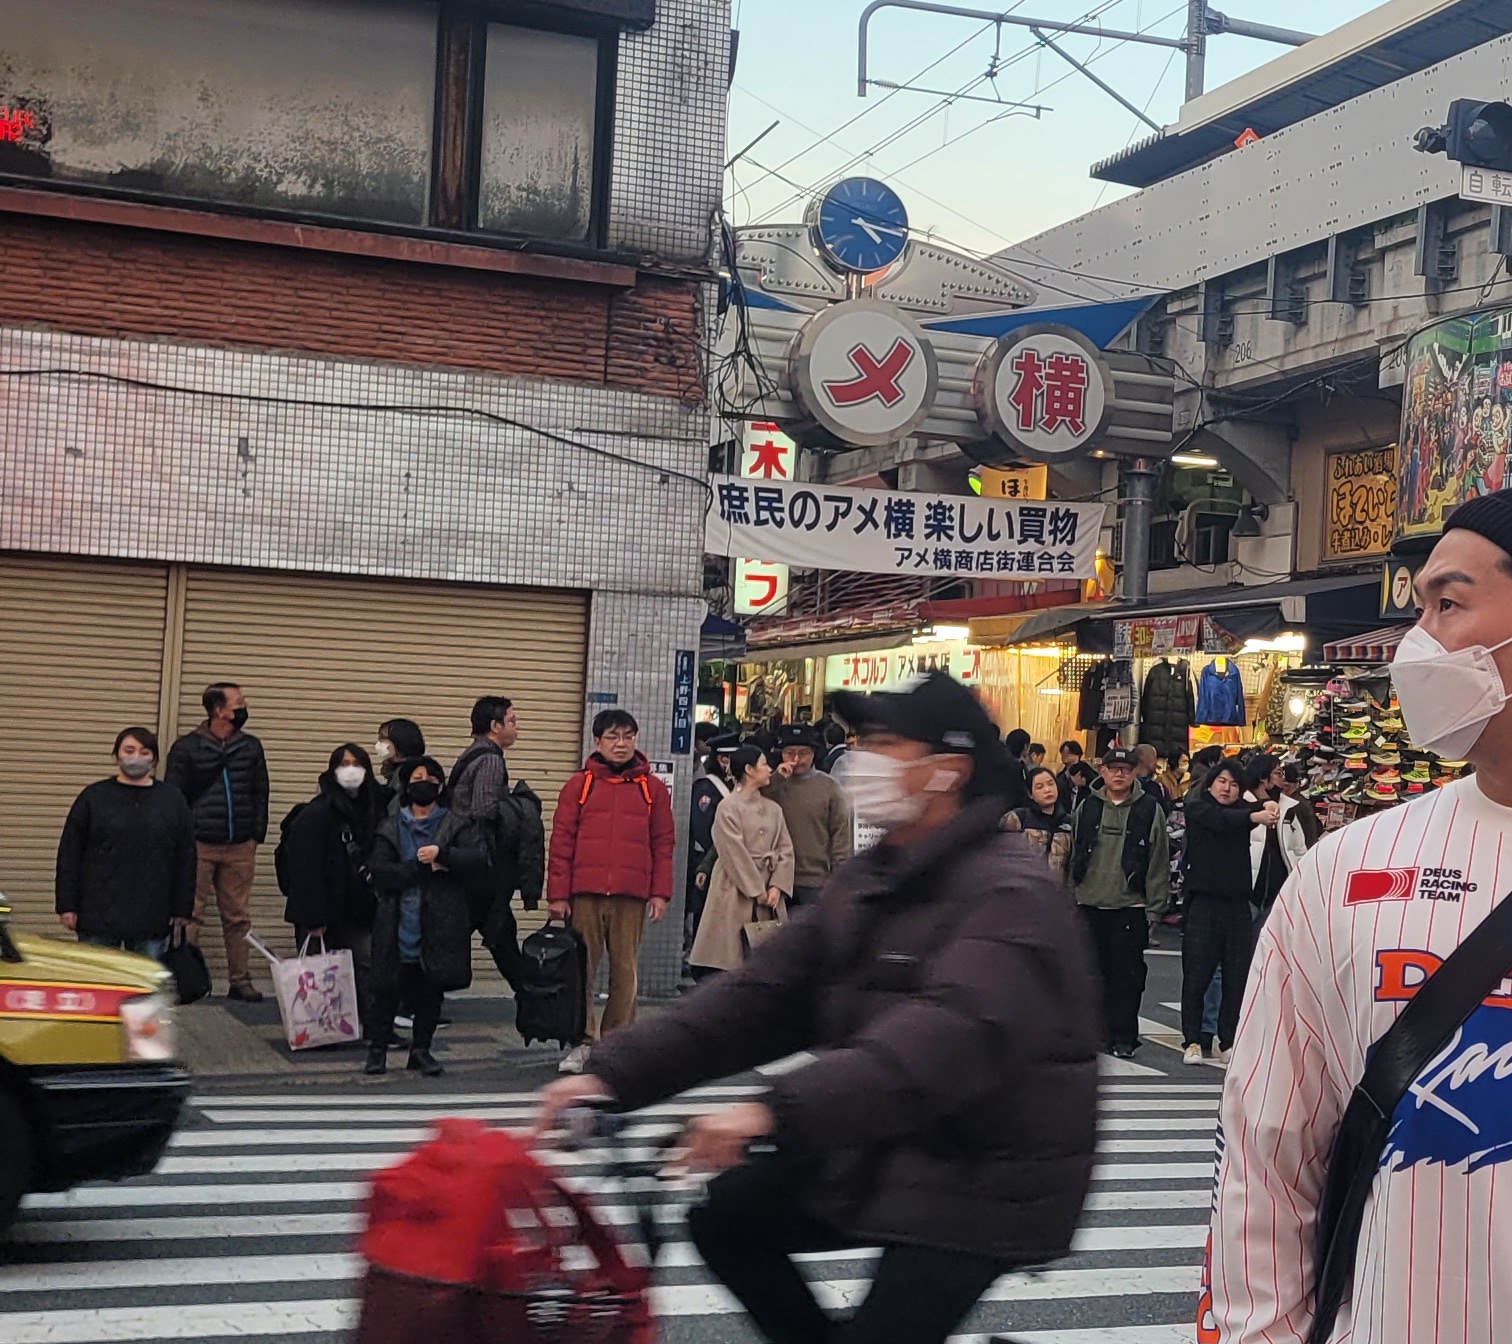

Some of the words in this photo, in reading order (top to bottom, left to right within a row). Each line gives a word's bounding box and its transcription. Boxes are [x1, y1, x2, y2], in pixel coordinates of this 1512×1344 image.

[1234, 340, 1252, 364] 206
[823, 337, 915, 408] メ
[1012, 350, 1088, 434] 横
[717, 483, 915, 540] 庶民のアメ横
[923, 500, 1080, 547] 楽しい買物
[893, 545, 1076, 574] アメ横商店街連合会
[677, 673, 692, 729] 上野四丁目
[678, 736, 684, 749] 1
[1420, 878, 1478, 893] RACING
[1422, 867, 1463, 880] DEUS
[1418, 889, 1461, 903] TEAM
